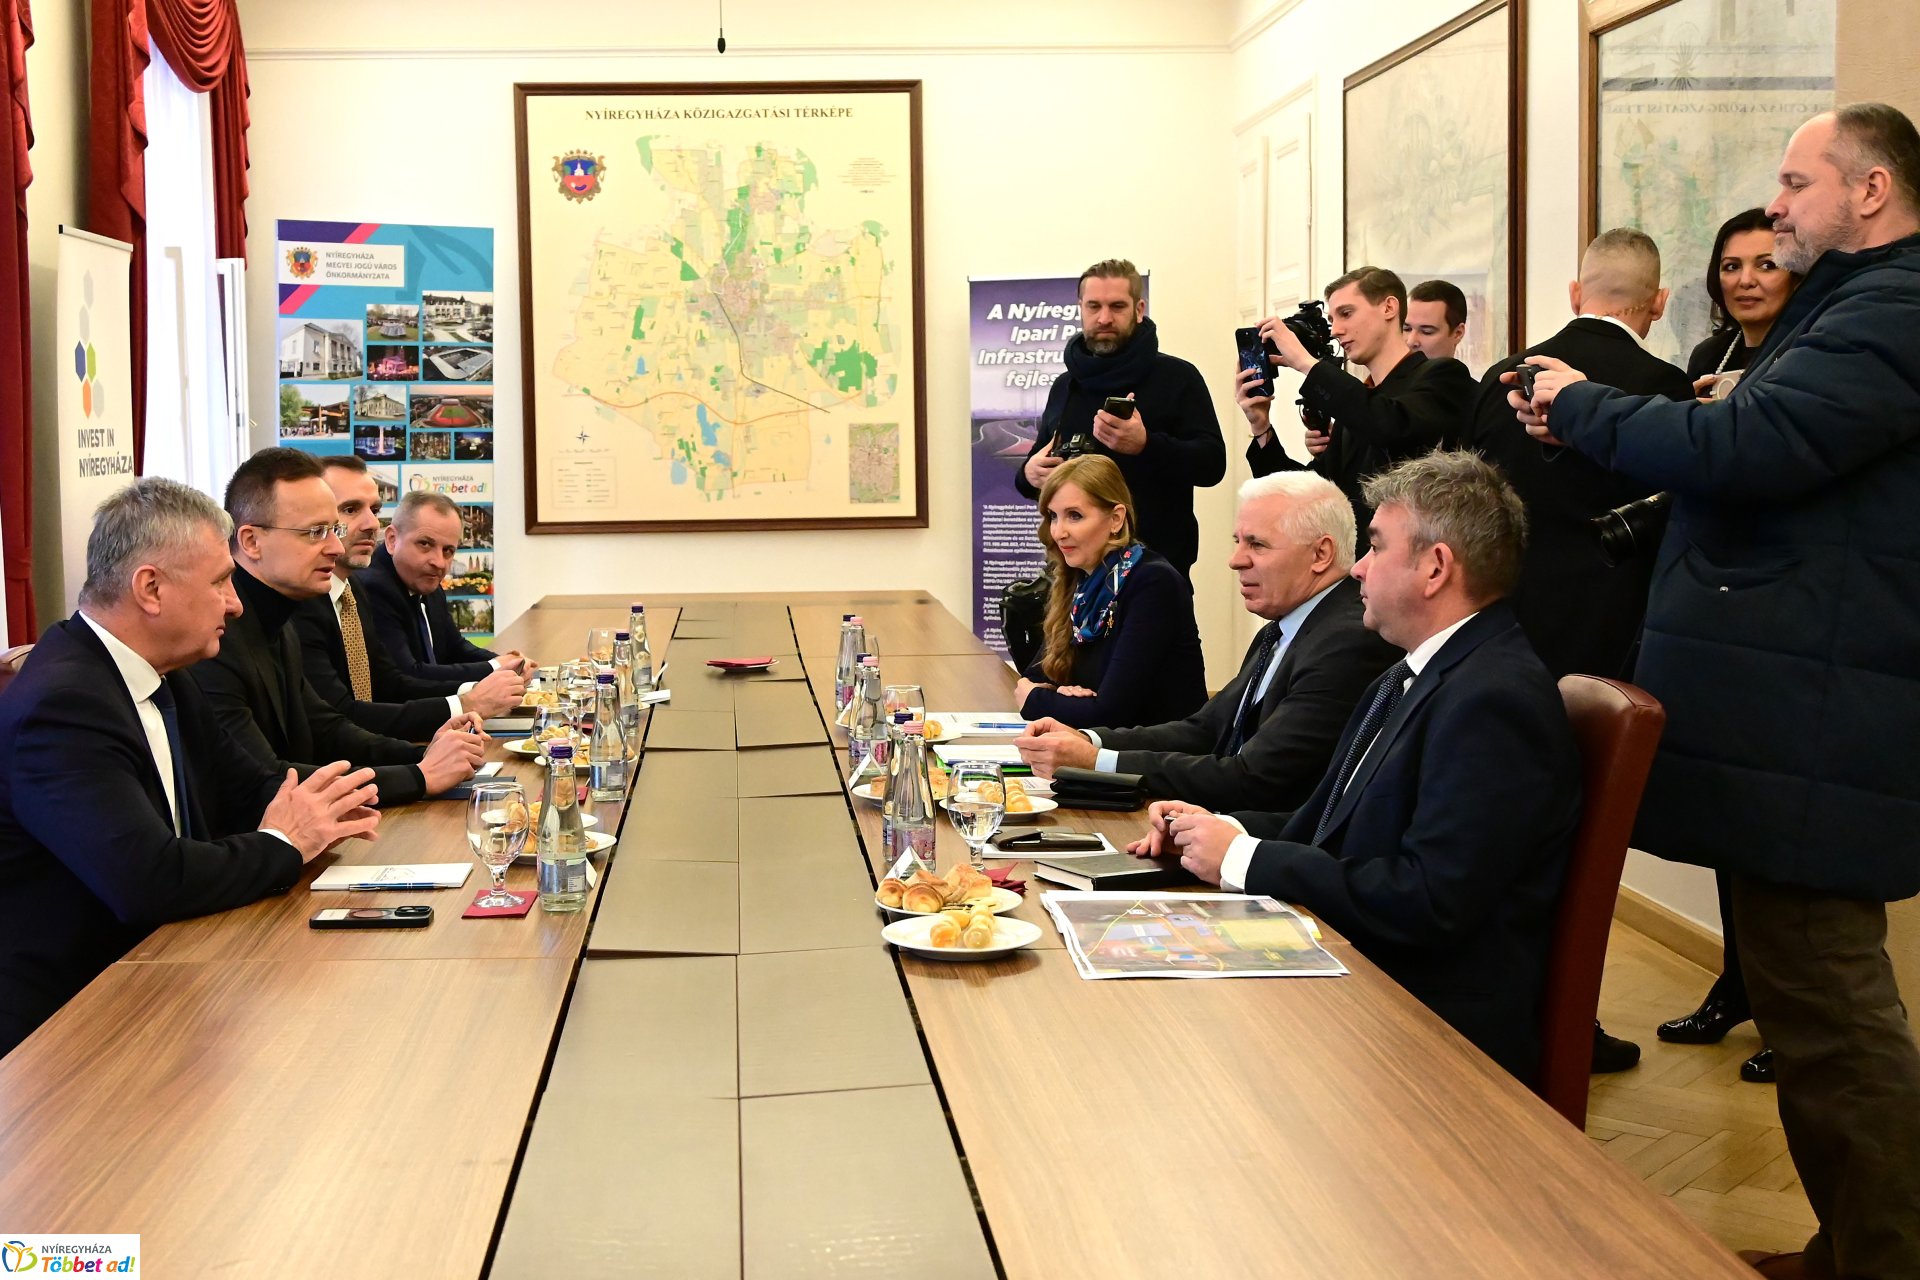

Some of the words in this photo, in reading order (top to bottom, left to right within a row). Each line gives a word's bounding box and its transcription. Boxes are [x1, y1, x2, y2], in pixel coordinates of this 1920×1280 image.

[585, 107, 680, 120] NYÍREGYHÁZA
[684, 105, 790, 119] KÖZIGAZGATÁSI
[794, 104, 853, 118] TÉRKÉPE
[354, 262, 373, 270] JOGÚ
[374, 262, 397, 270] VÁROS
[326, 271, 389, 279] ÖNKORMÁNYZATA
[987, 304, 1003, 320] A
[1010, 324, 1059, 345] Ipari
[78, 429, 104, 448] INVEST
[107, 428, 114, 447] IN
[79, 451, 133, 477] NYÍREGYHÁZA
[432, 483, 468, 493] Többet
